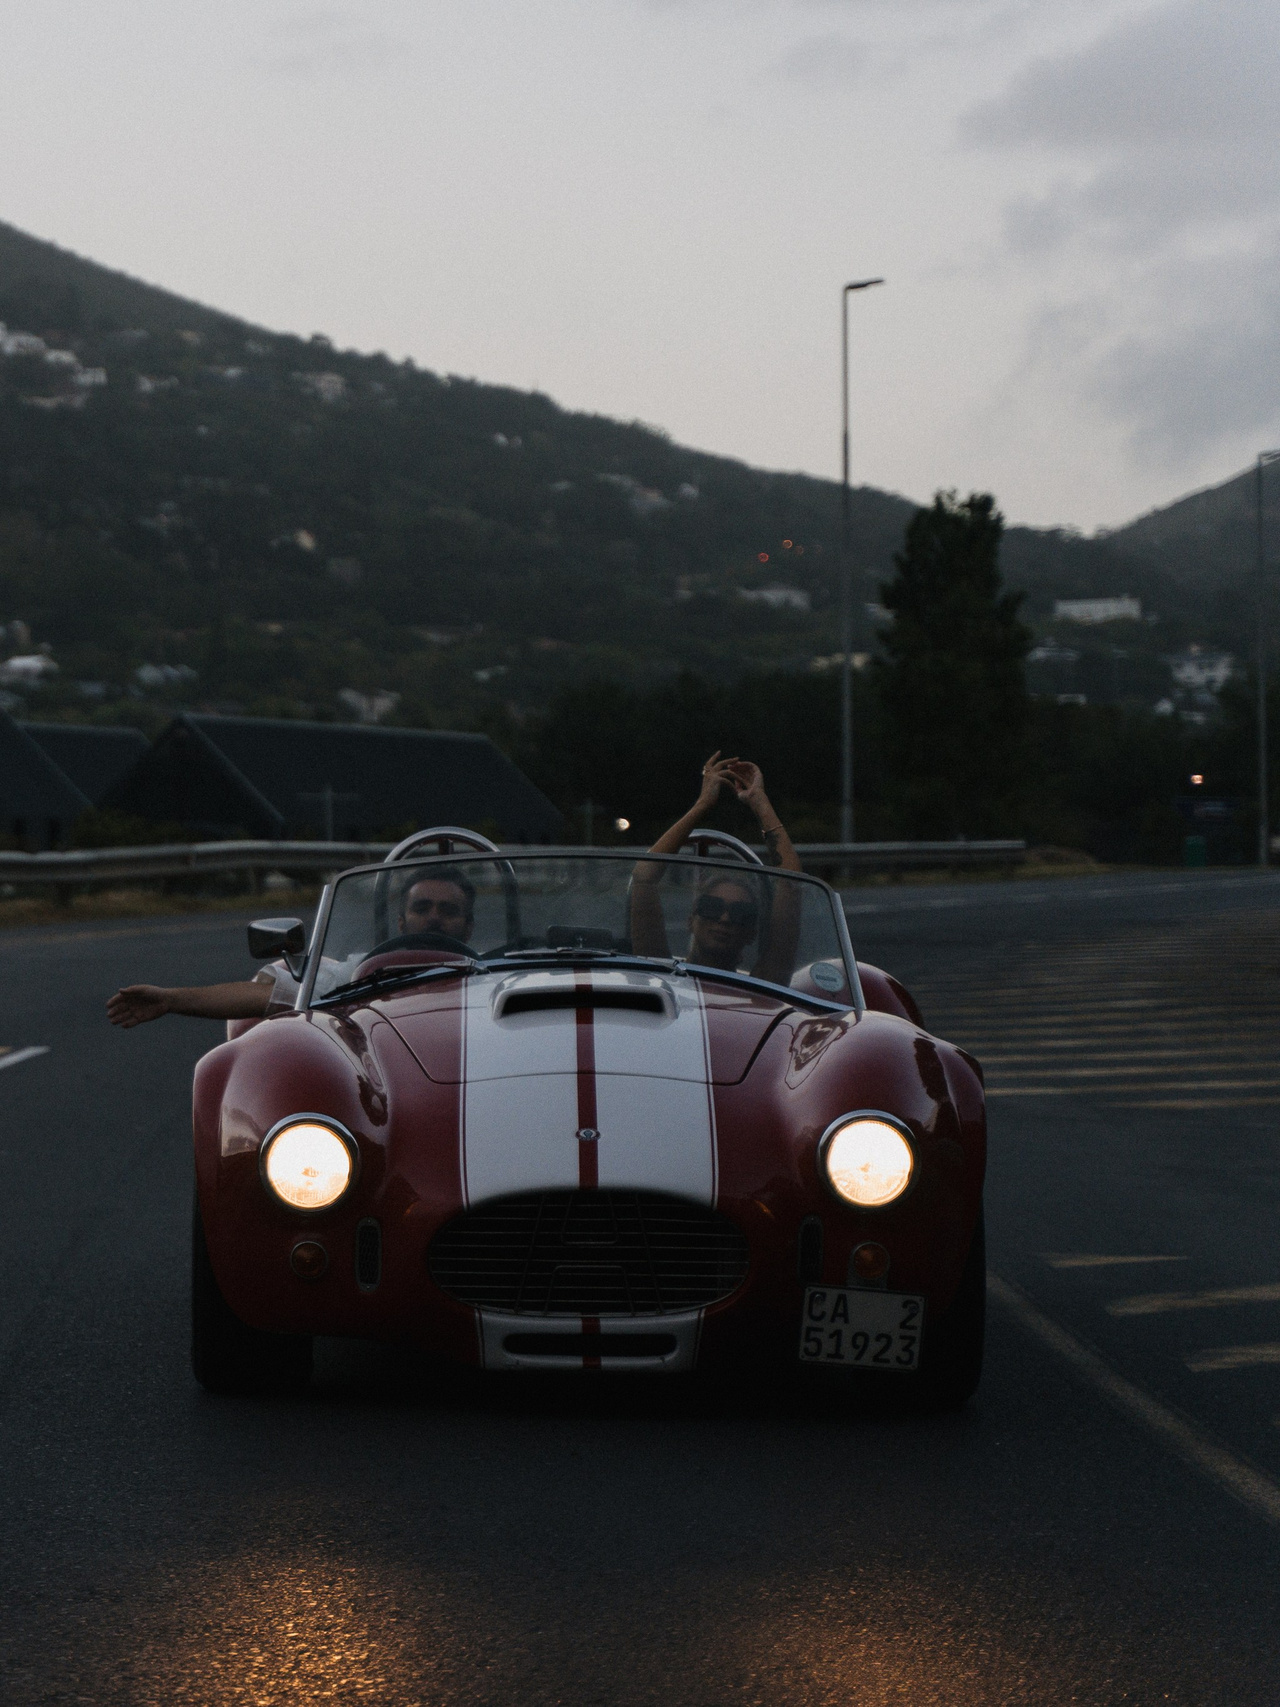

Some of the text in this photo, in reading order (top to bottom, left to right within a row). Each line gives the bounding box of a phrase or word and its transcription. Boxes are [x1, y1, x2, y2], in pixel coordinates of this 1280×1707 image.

[808, 1291, 919, 1330] CA 2
[803, 1326, 917, 1365] 51923
